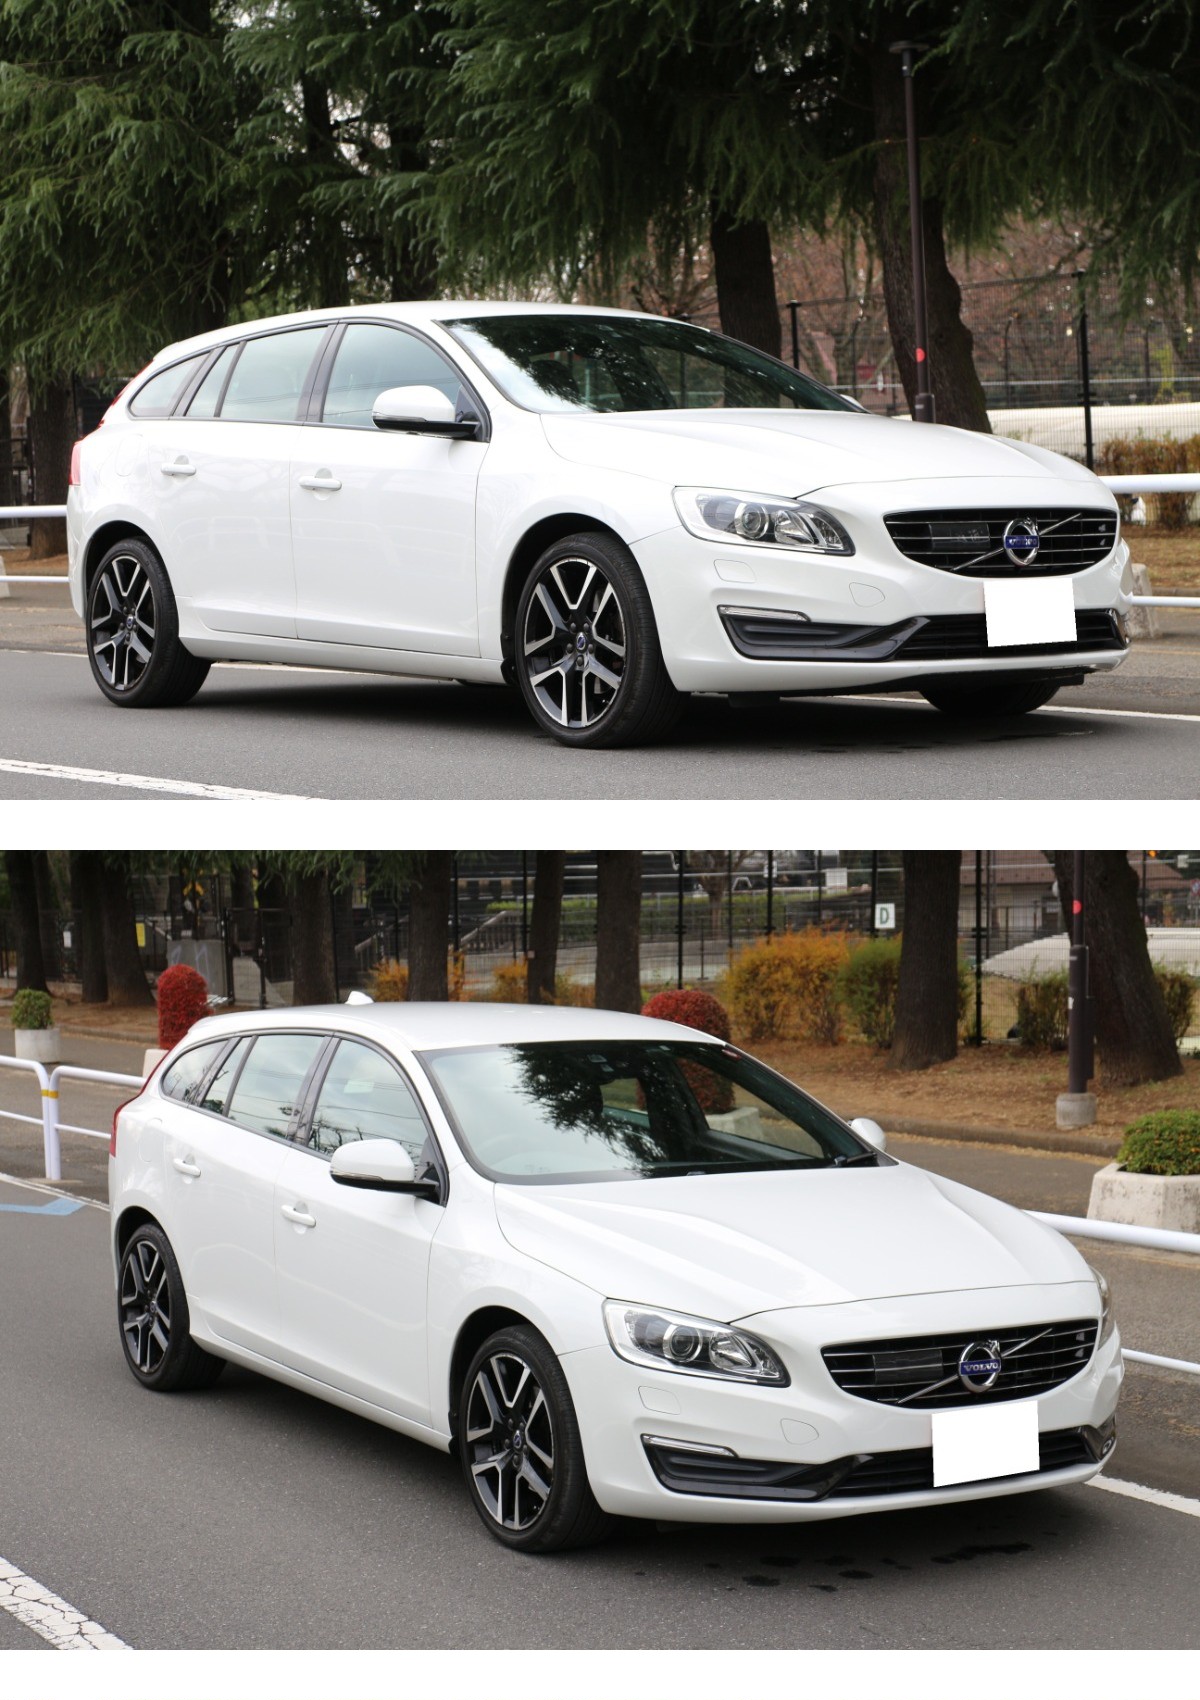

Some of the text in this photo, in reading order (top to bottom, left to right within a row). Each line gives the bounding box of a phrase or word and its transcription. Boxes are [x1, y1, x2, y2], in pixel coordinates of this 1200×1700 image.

[1008, 537, 1037, 547] VVO
[879, 906, 890, 925] D
[962, 1361, 999, 1373] VOLVO
